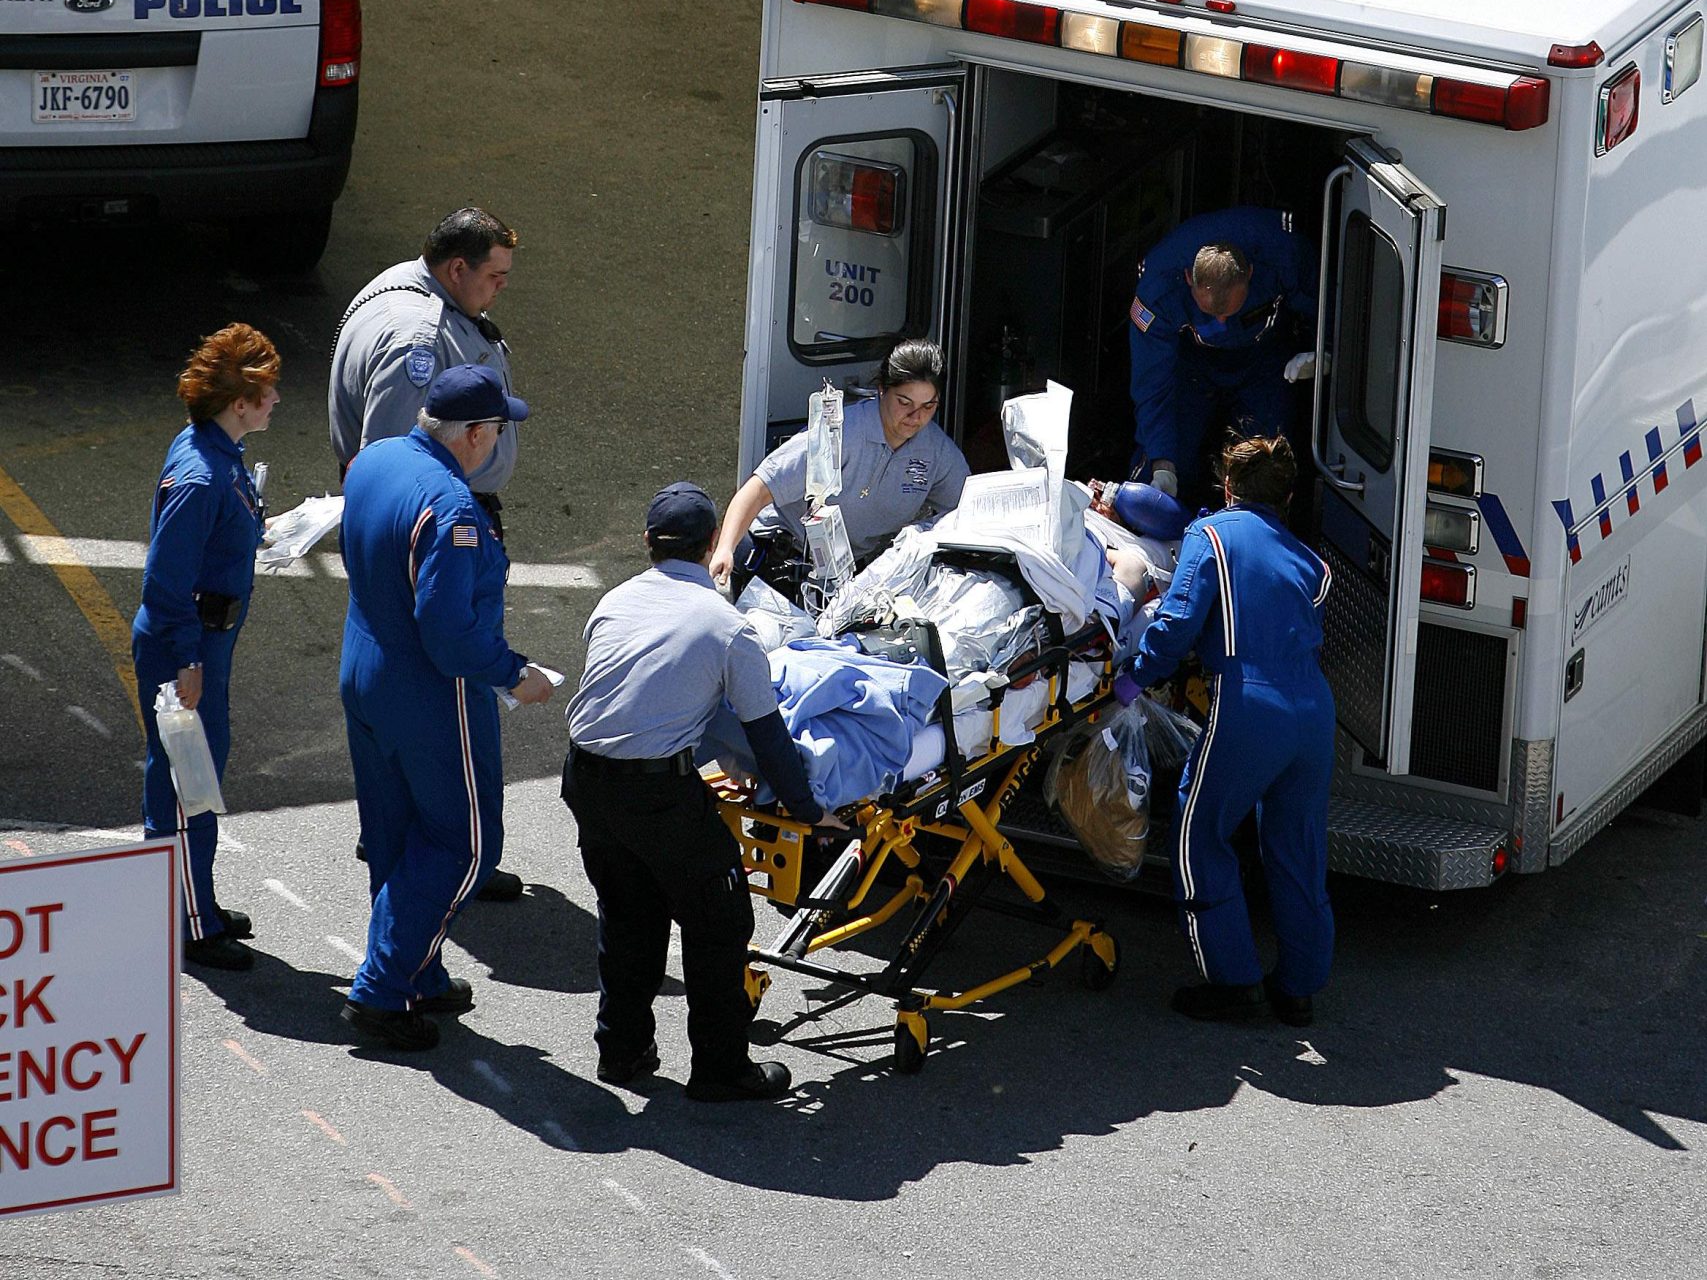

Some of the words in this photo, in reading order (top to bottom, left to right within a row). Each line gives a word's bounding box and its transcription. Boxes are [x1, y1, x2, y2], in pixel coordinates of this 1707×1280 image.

[60, 74, 109, 84] VIRGINIA
[39, 85, 129, 111] JKF-6790
[825, 259, 881, 284] UNIT
[828, 282, 875, 307] 200
[0, 1108, 118, 1173] NCE
